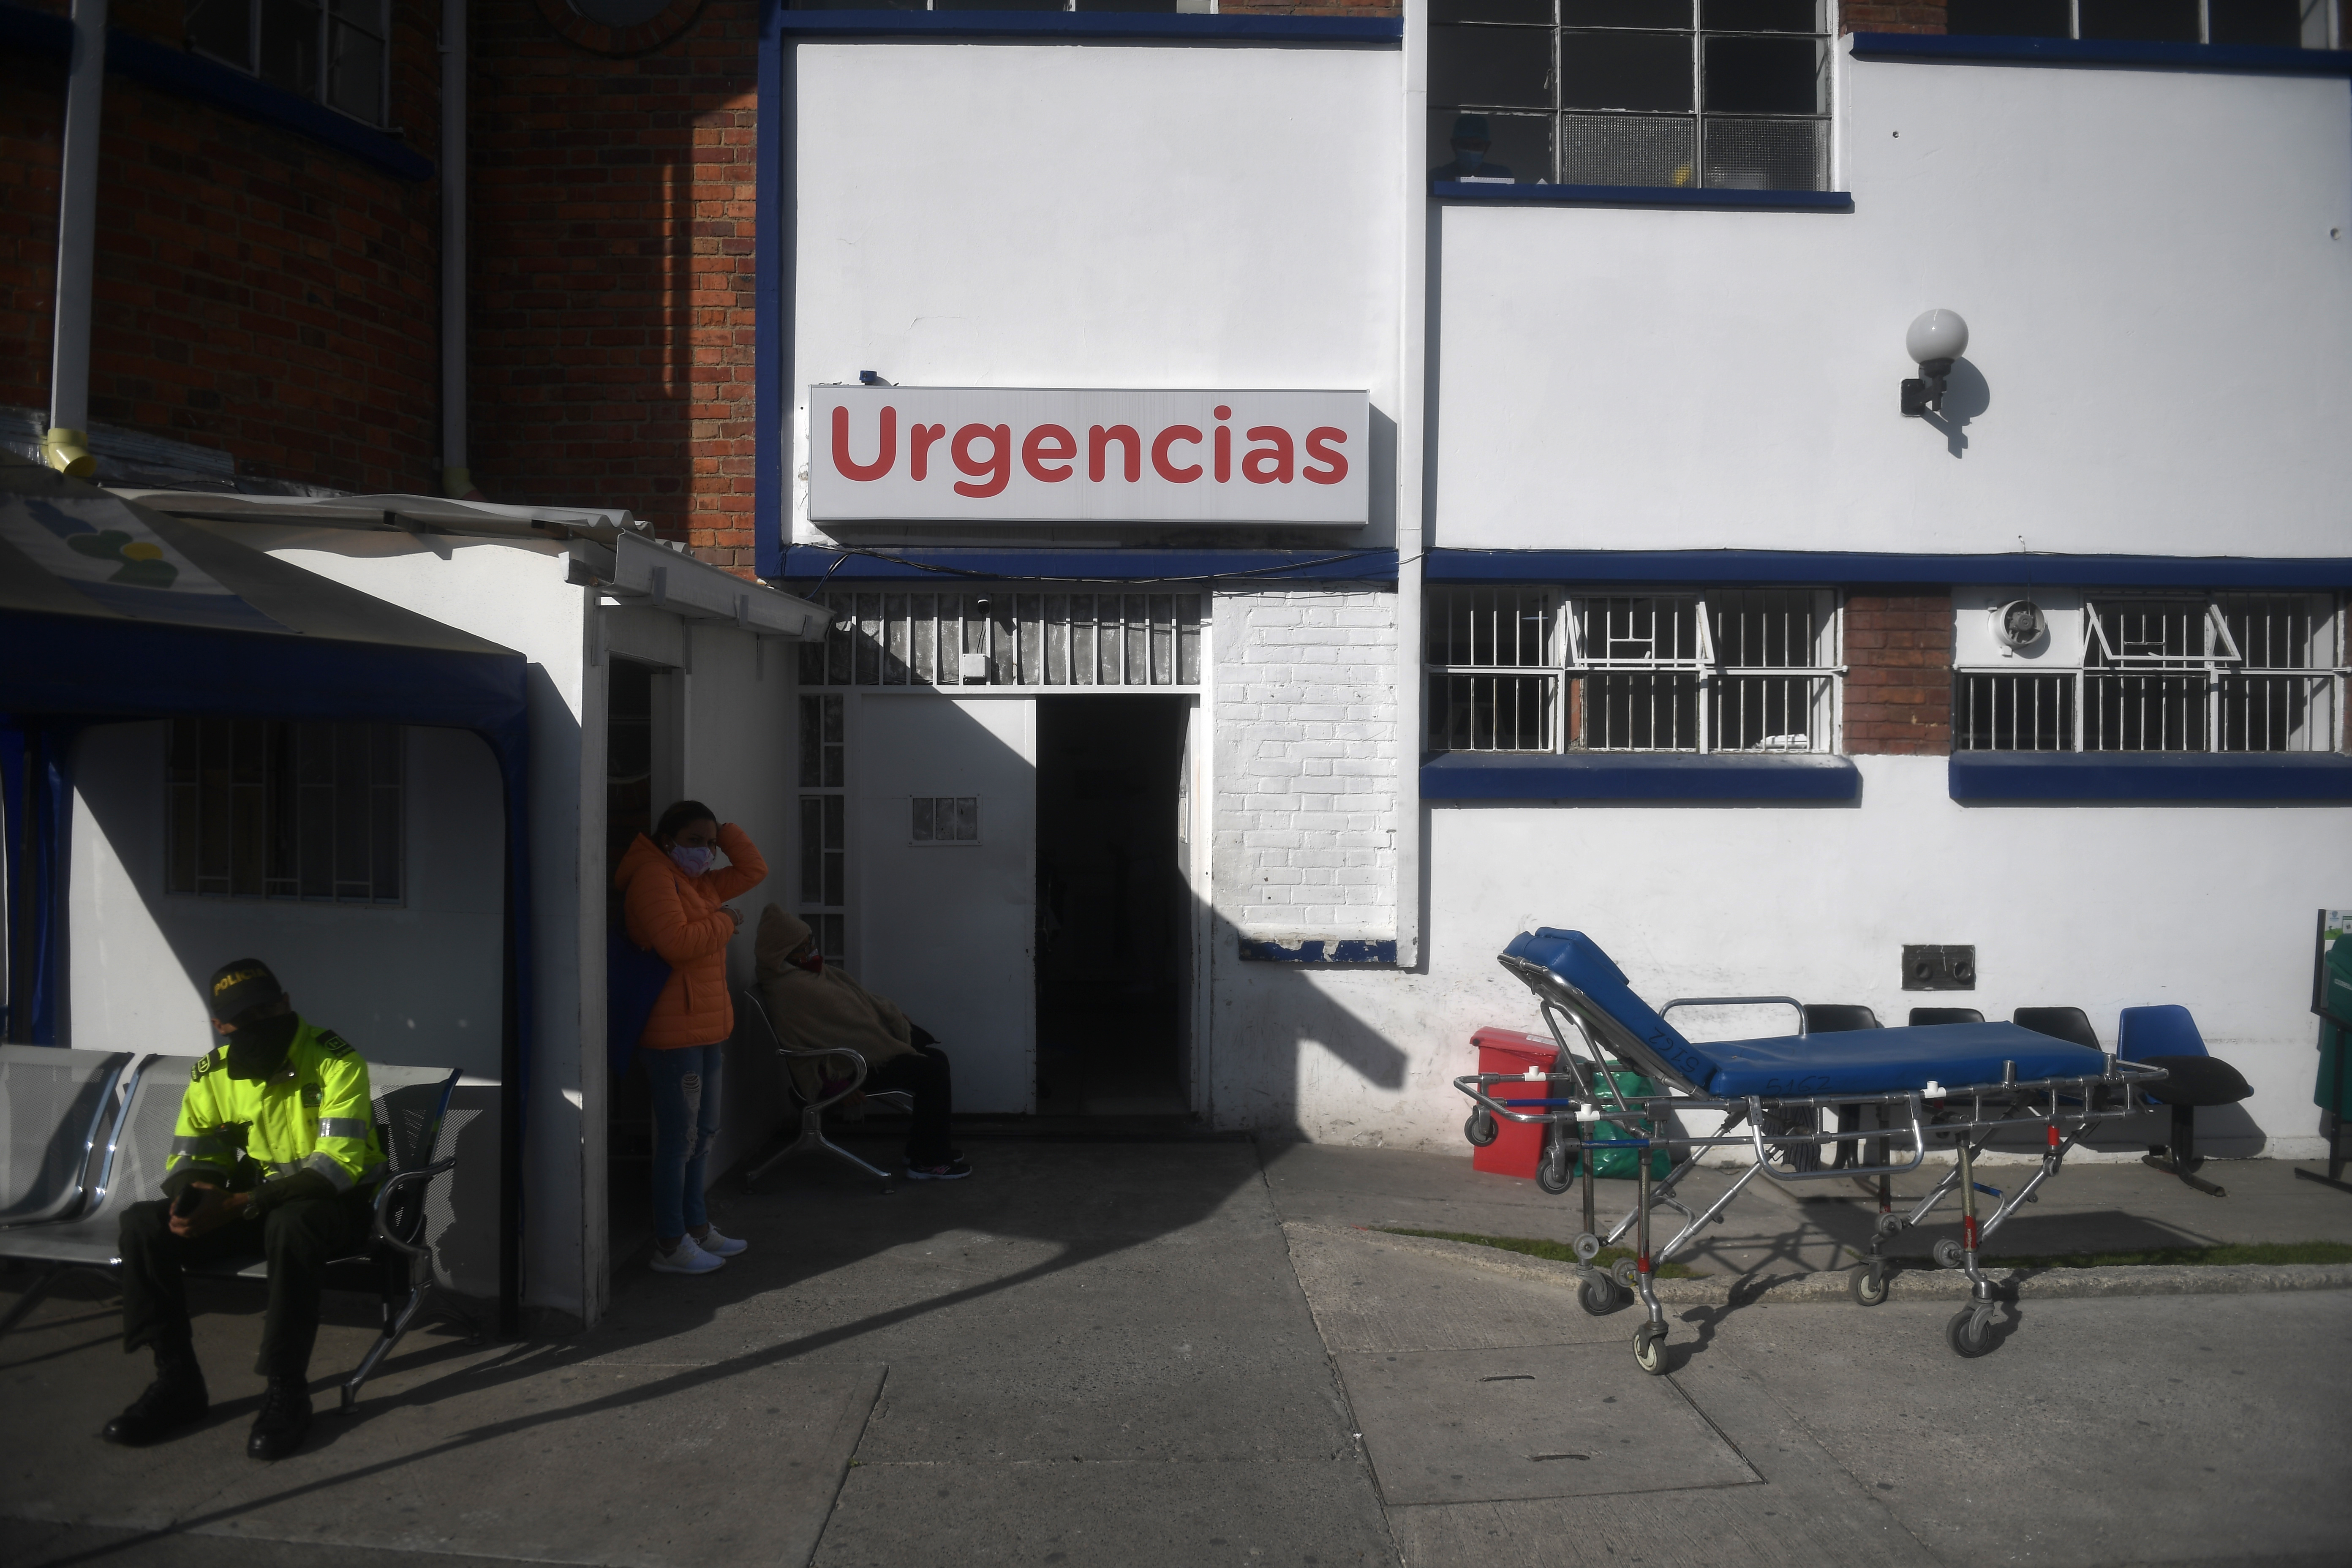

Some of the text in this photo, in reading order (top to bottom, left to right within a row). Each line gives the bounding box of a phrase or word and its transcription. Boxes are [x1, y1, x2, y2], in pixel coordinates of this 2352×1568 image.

[832, 406, 1349, 498] Urgencias
[214, 968, 268, 996] POLICIA
[1649, 1027, 1699, 1073] 5162
[1766, 1076, 1832, 1096] 5162
